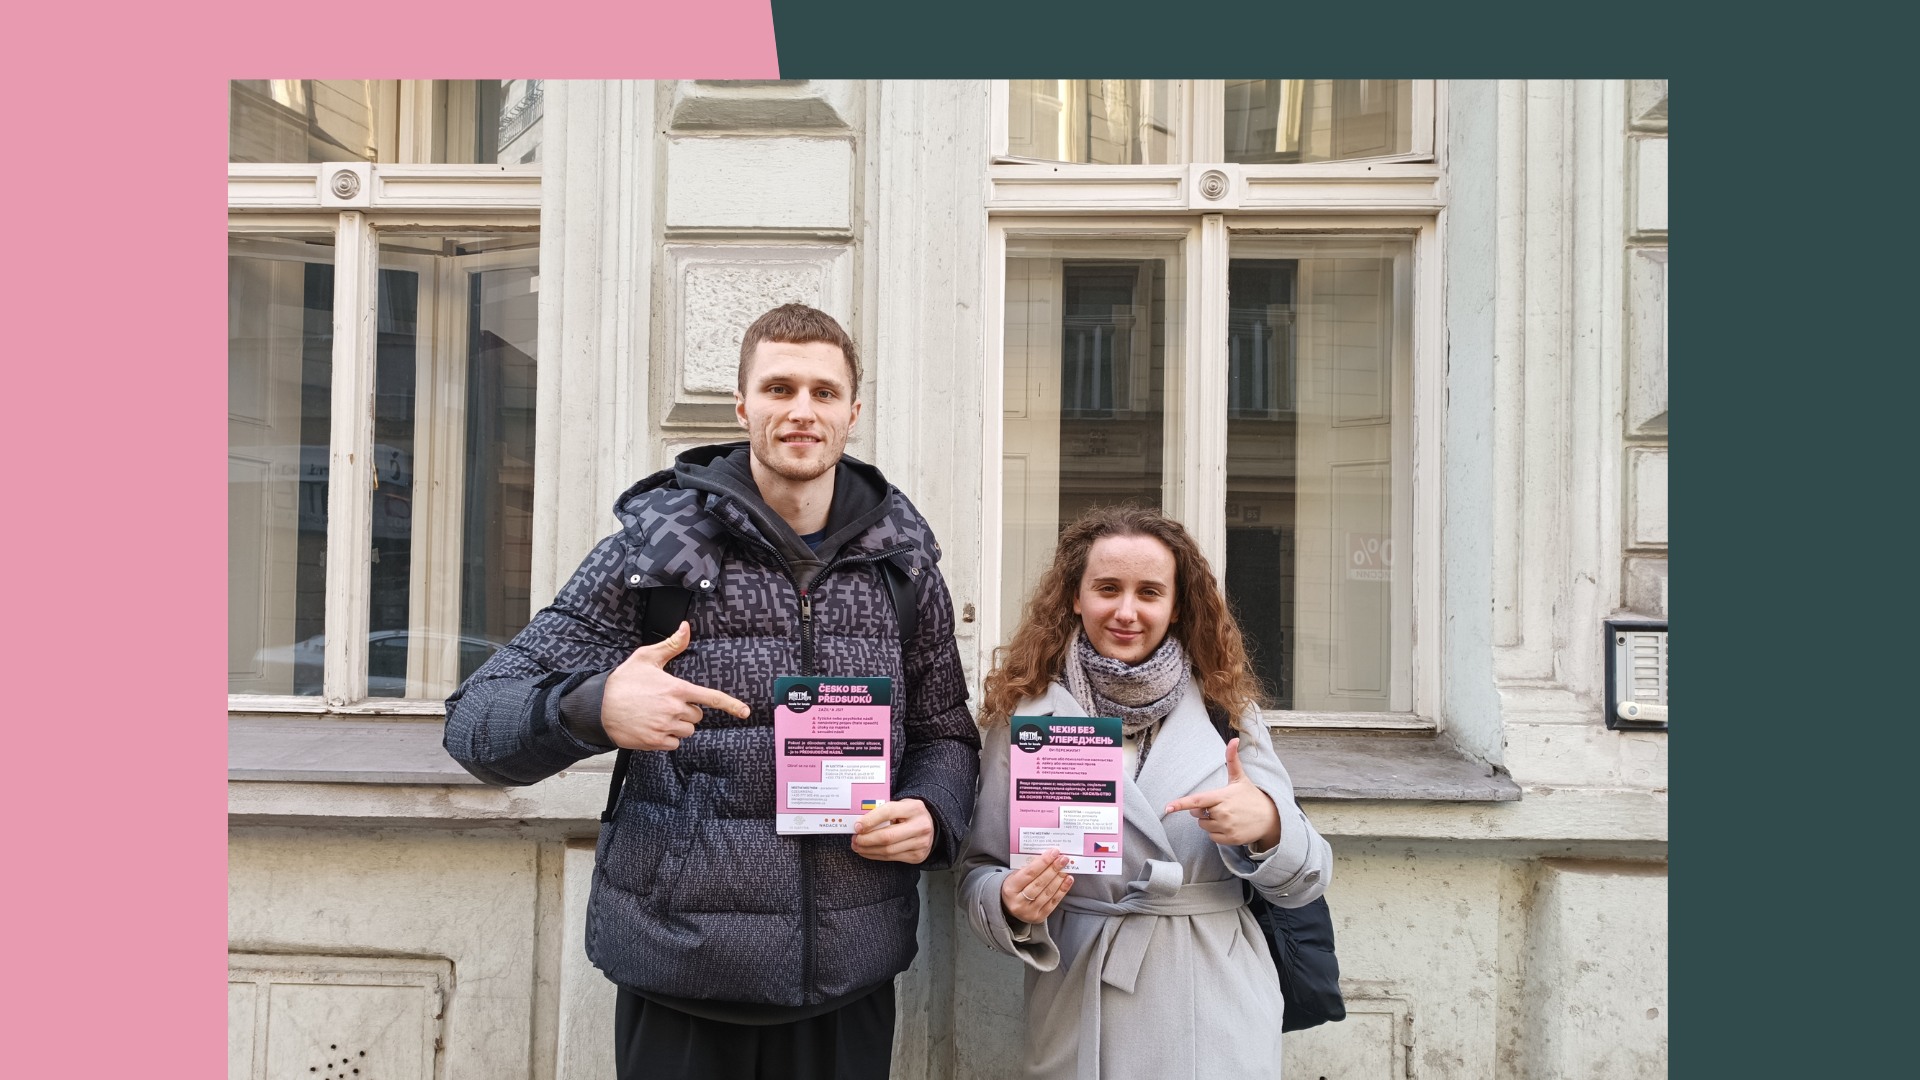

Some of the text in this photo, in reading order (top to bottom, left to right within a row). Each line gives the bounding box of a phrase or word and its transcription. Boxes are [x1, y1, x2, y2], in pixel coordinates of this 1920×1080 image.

[818, 683, 849, 693] ČESKO
[818, 694, 872, 703] PŘEDSUDKŮ
[1049, 725, 1095, 734] ЧЕХІЯ БЕЗ
[1049, 736, 1114, 746] УПЕРЕДЖЕНЬ
